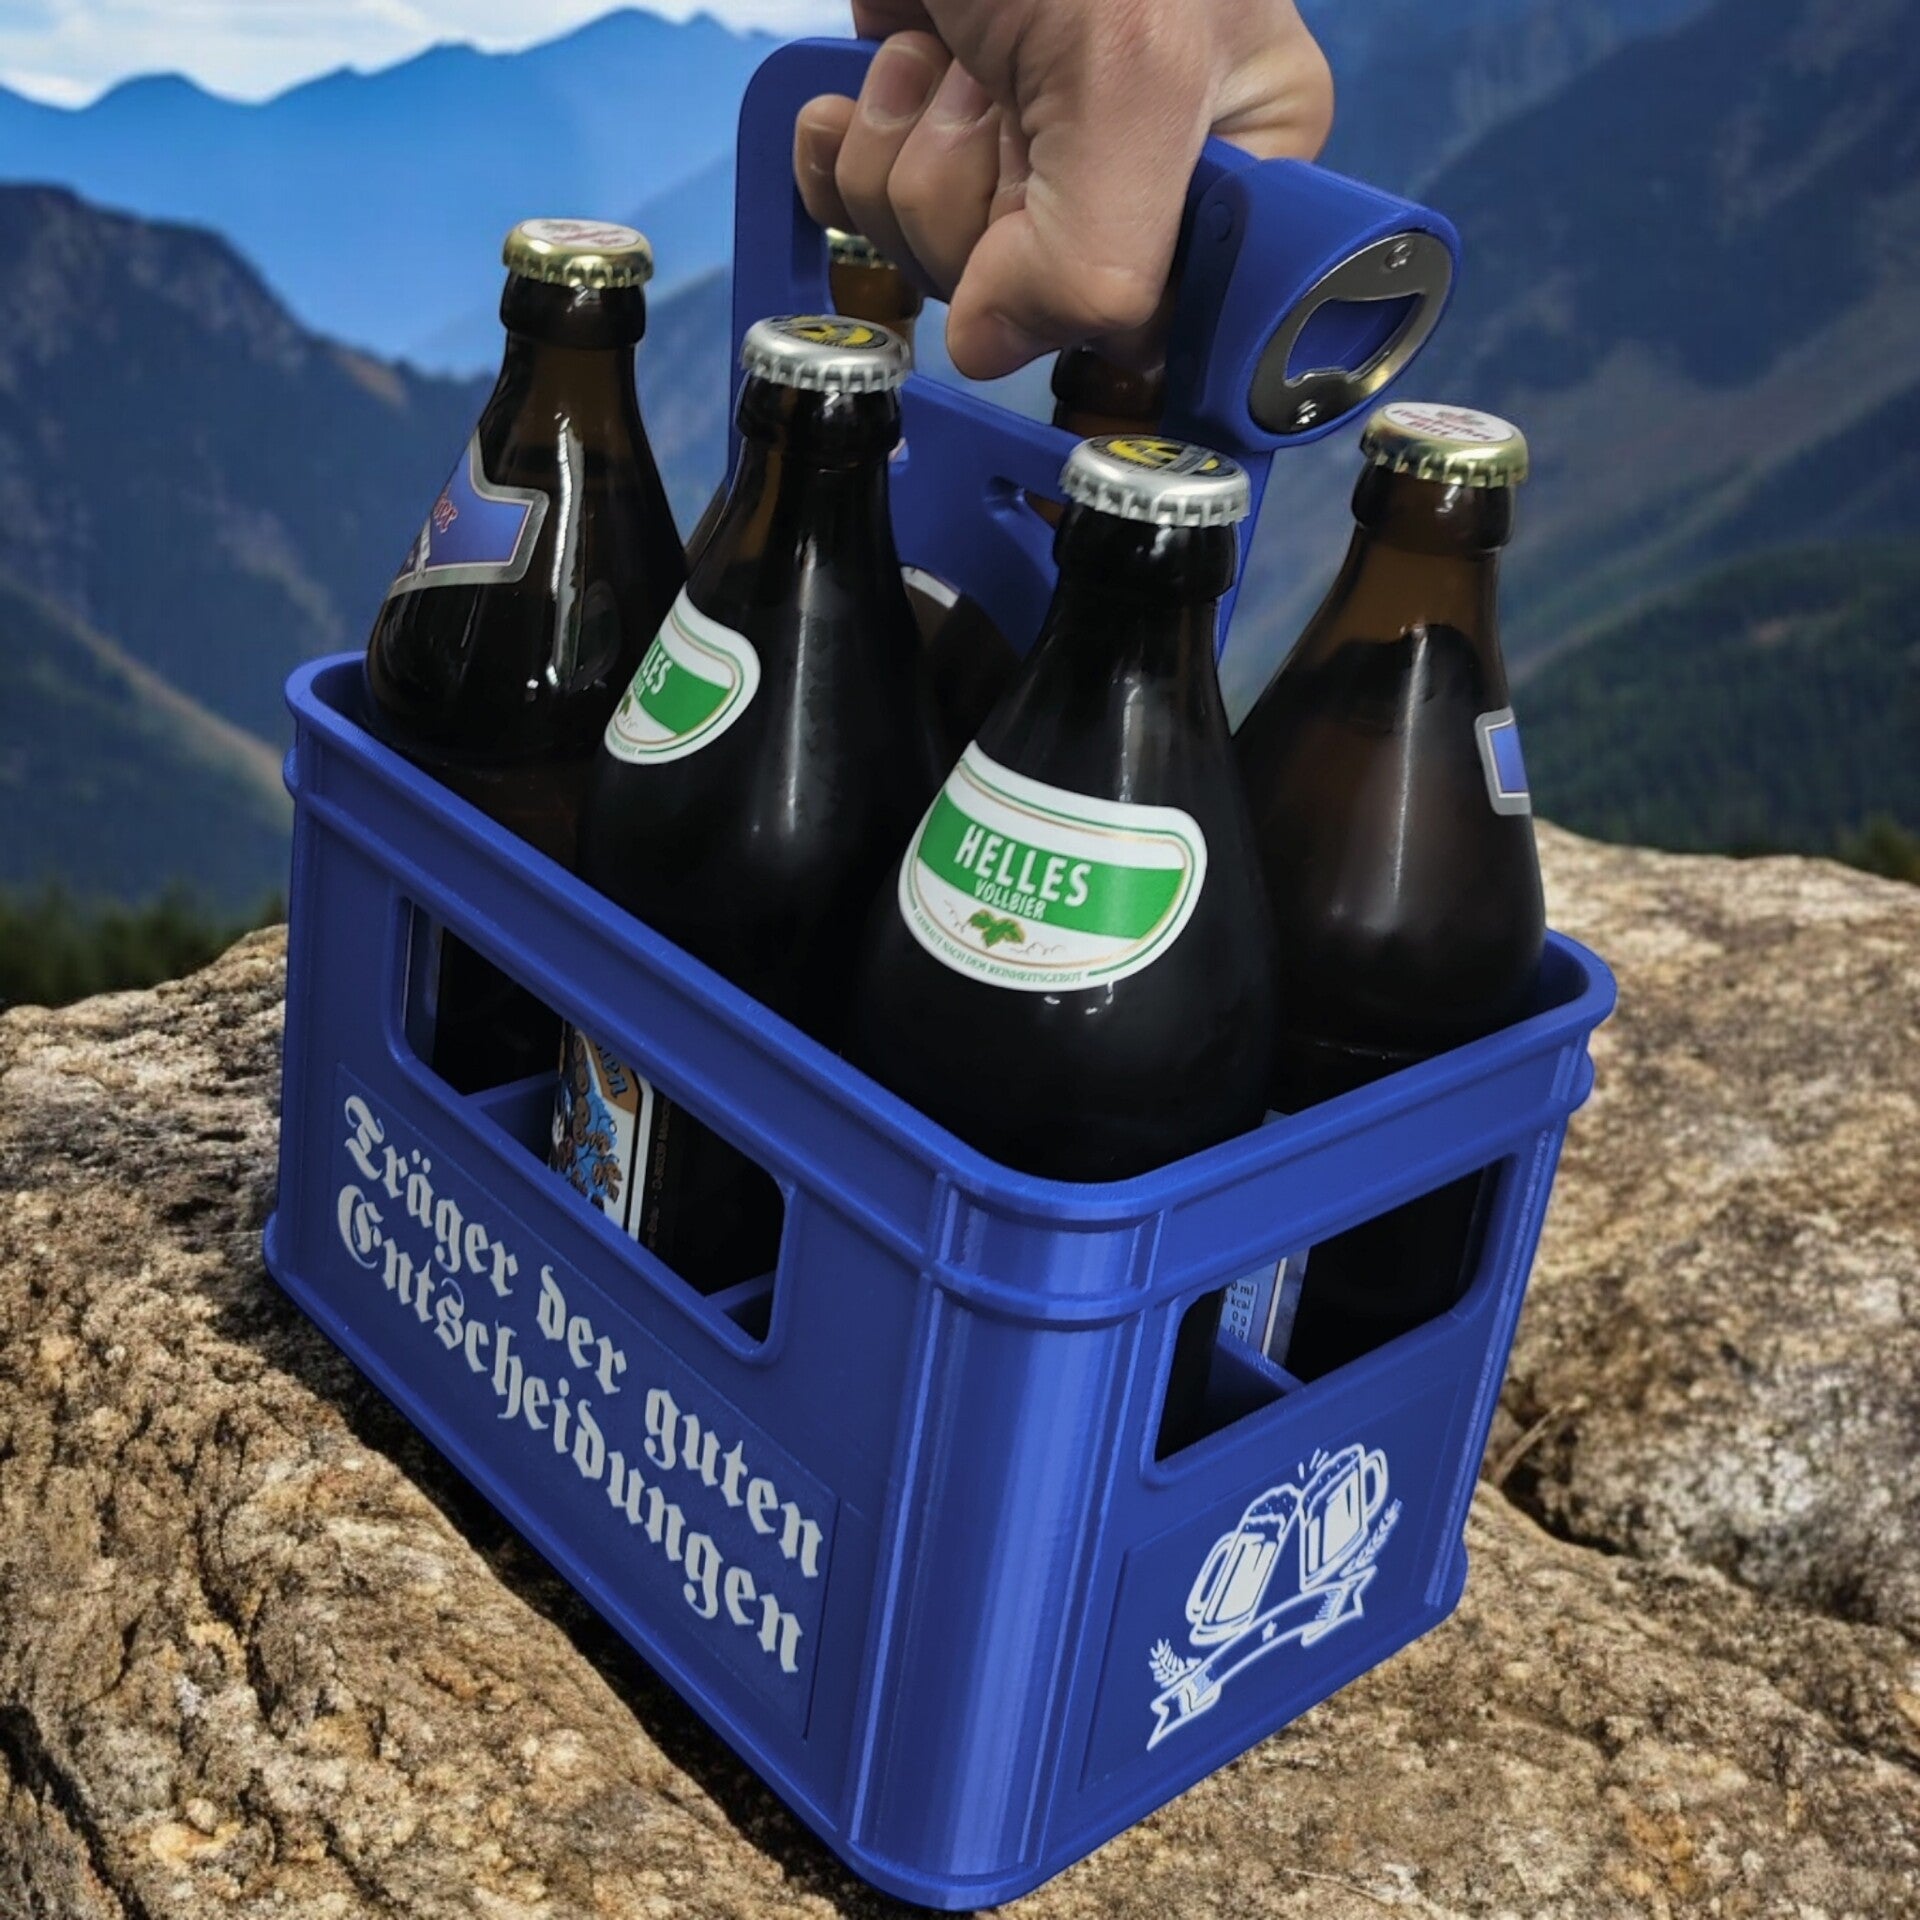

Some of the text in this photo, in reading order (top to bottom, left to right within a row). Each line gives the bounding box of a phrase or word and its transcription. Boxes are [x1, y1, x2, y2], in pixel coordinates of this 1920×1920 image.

[954, 823, 1093, 907] HELLES
[974, 879, 1047, 920] VOLLBIER
[1231, 1295, 1250, 1310] kcal
[1240, 1284, 1254, 1296] ml
[344, 1095, 519, 1298] Träger
[536, 1264, 628, 1395] der
[644, 1387, 824, 1578] guten
[336, 1184, 803, 1674] Entscheidungen
